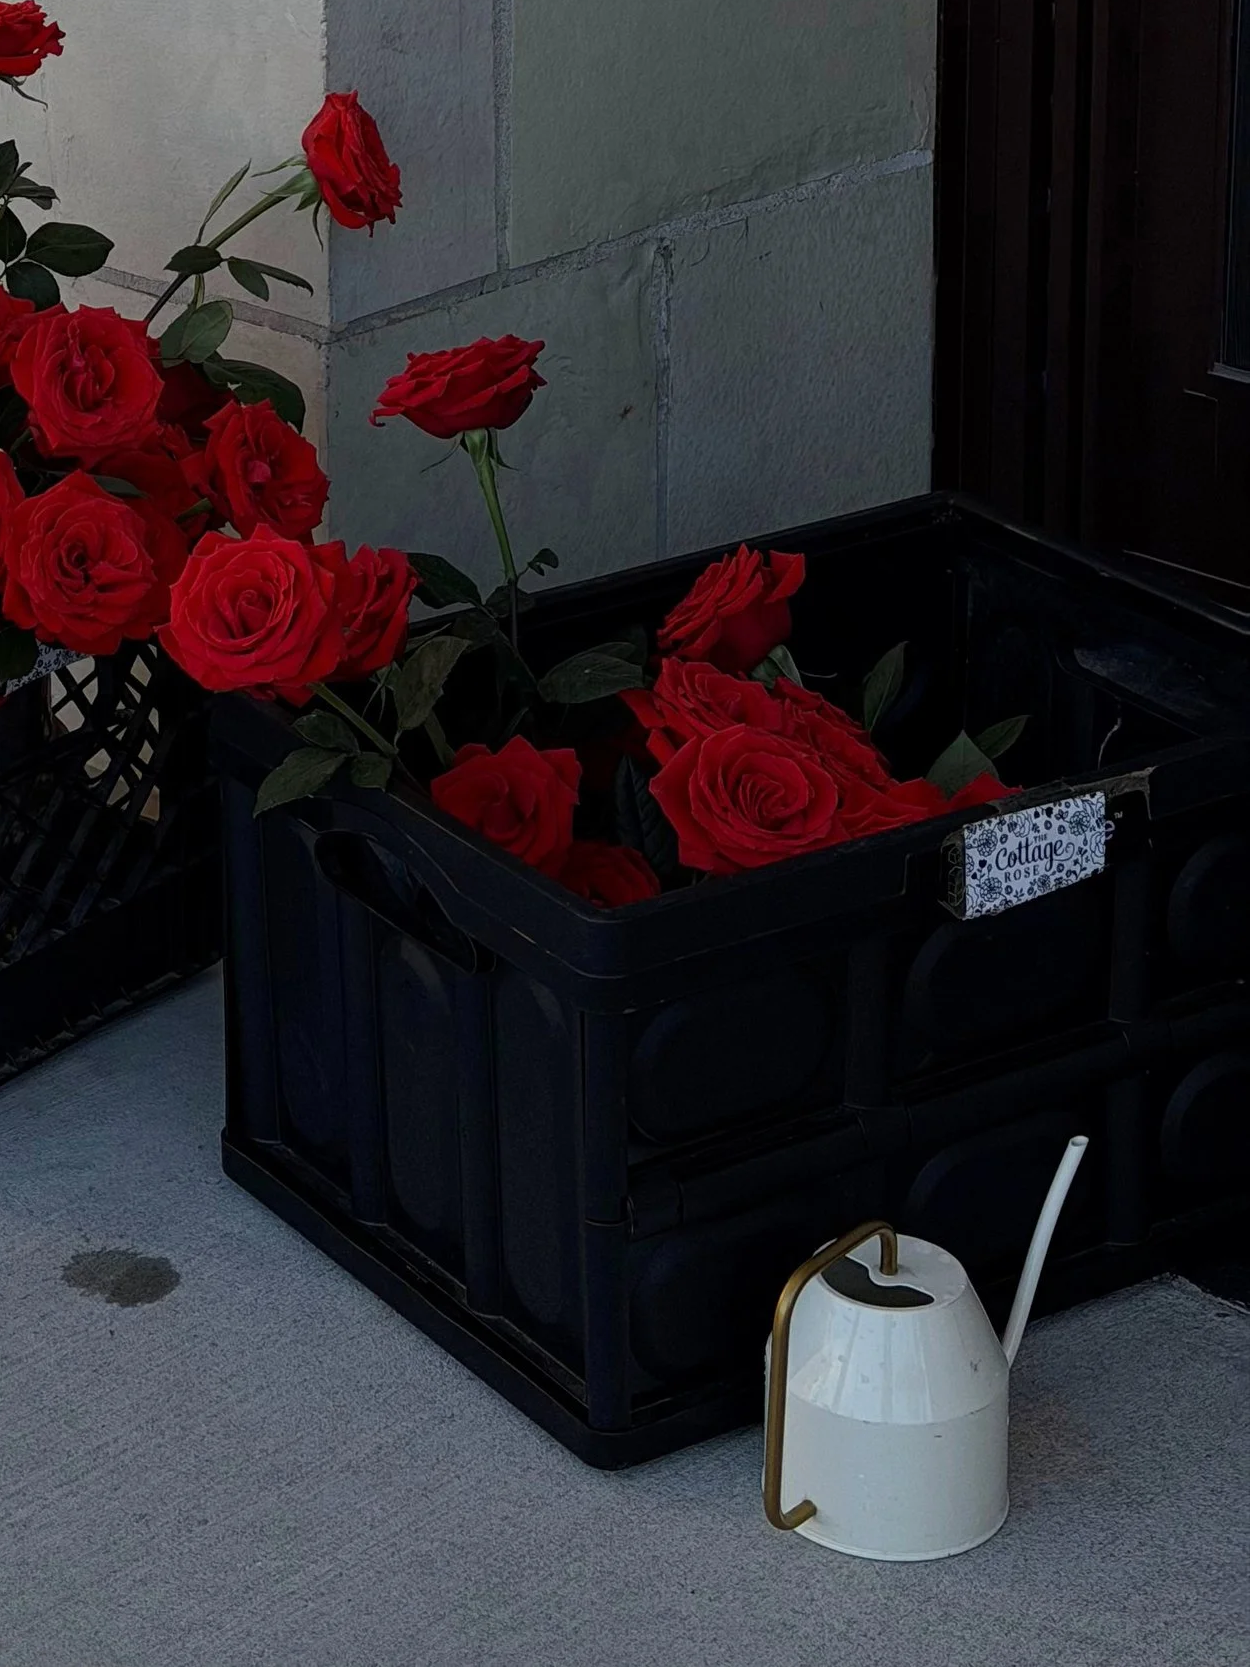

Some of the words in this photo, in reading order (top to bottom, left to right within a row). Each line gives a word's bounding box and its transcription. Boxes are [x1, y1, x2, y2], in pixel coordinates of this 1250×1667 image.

[1033, 834, 1048, 843] THE
[995, 836, 1076, 873] Cottage
[1004, 864, 1039, 883] ROSE
